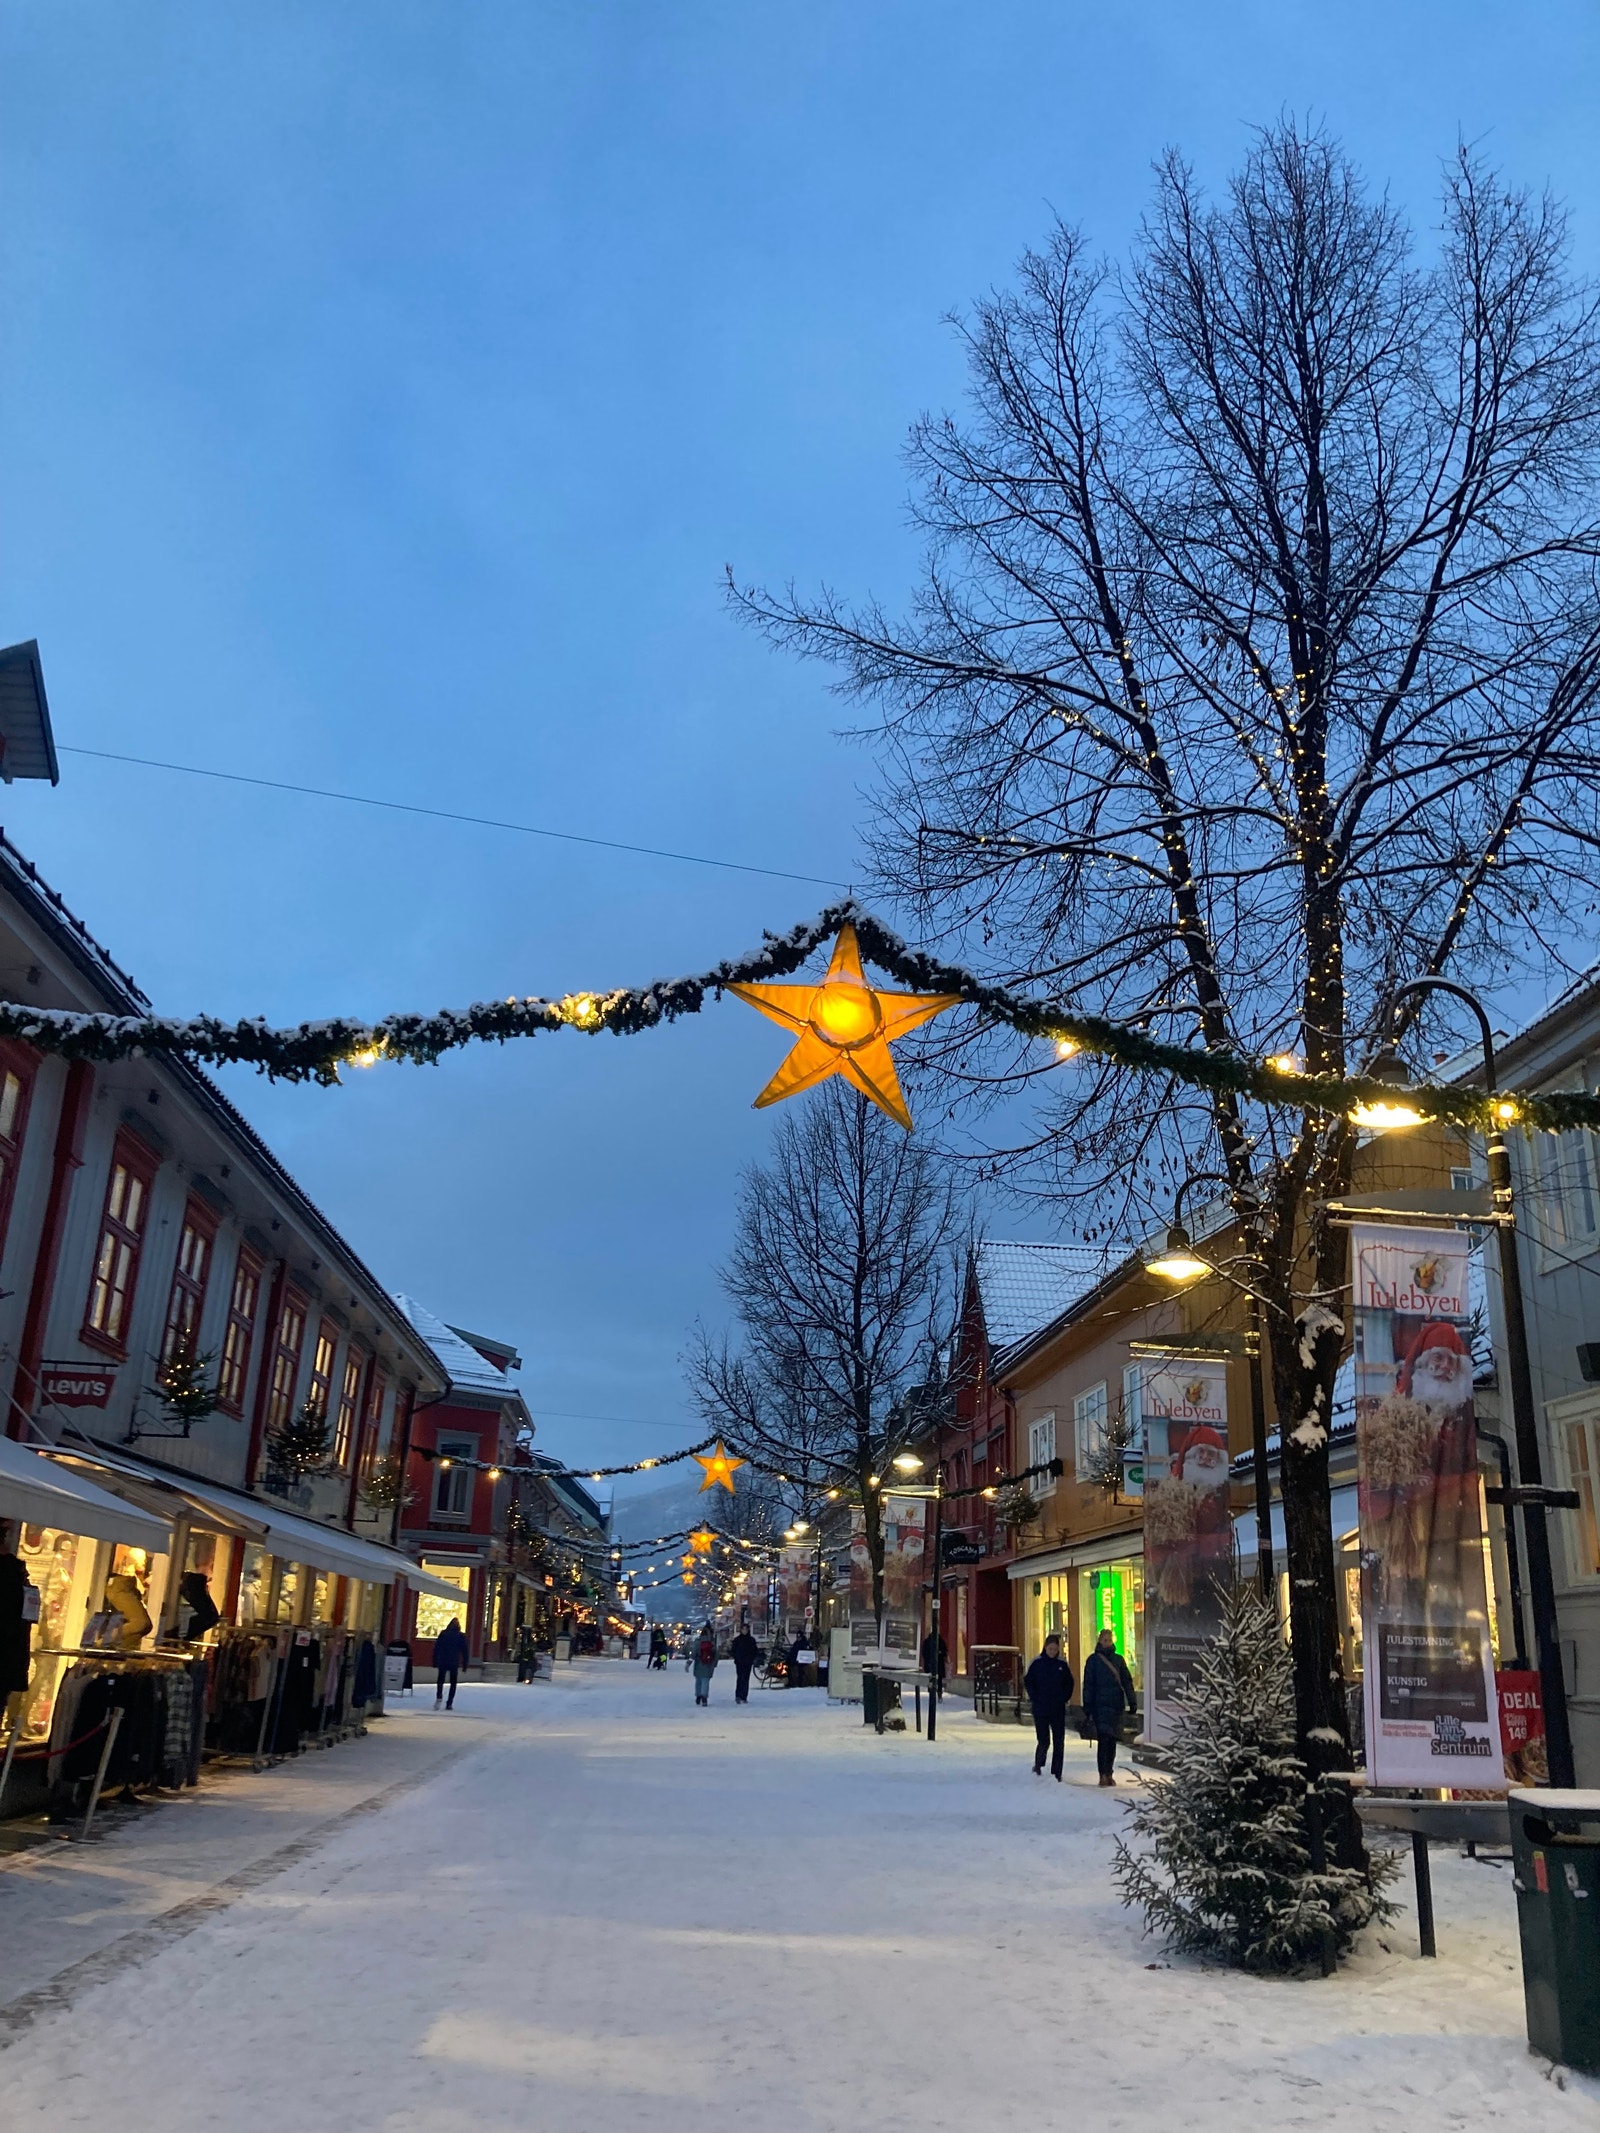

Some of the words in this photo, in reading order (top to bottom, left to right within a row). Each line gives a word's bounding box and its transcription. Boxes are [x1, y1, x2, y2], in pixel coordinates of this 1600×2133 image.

[1367, 1281, 1462, 1320] Julebyen
[1152, 1398, 1222, 1424] Julebyen
[1387, 1675, 1428, 1687] KUNSTIG
[1503, 1691, 1541, 1709] DEAL
[1508, 1726, 1527, 1740] 149
[1431, 1740, 1490, 1755] Sentrum
